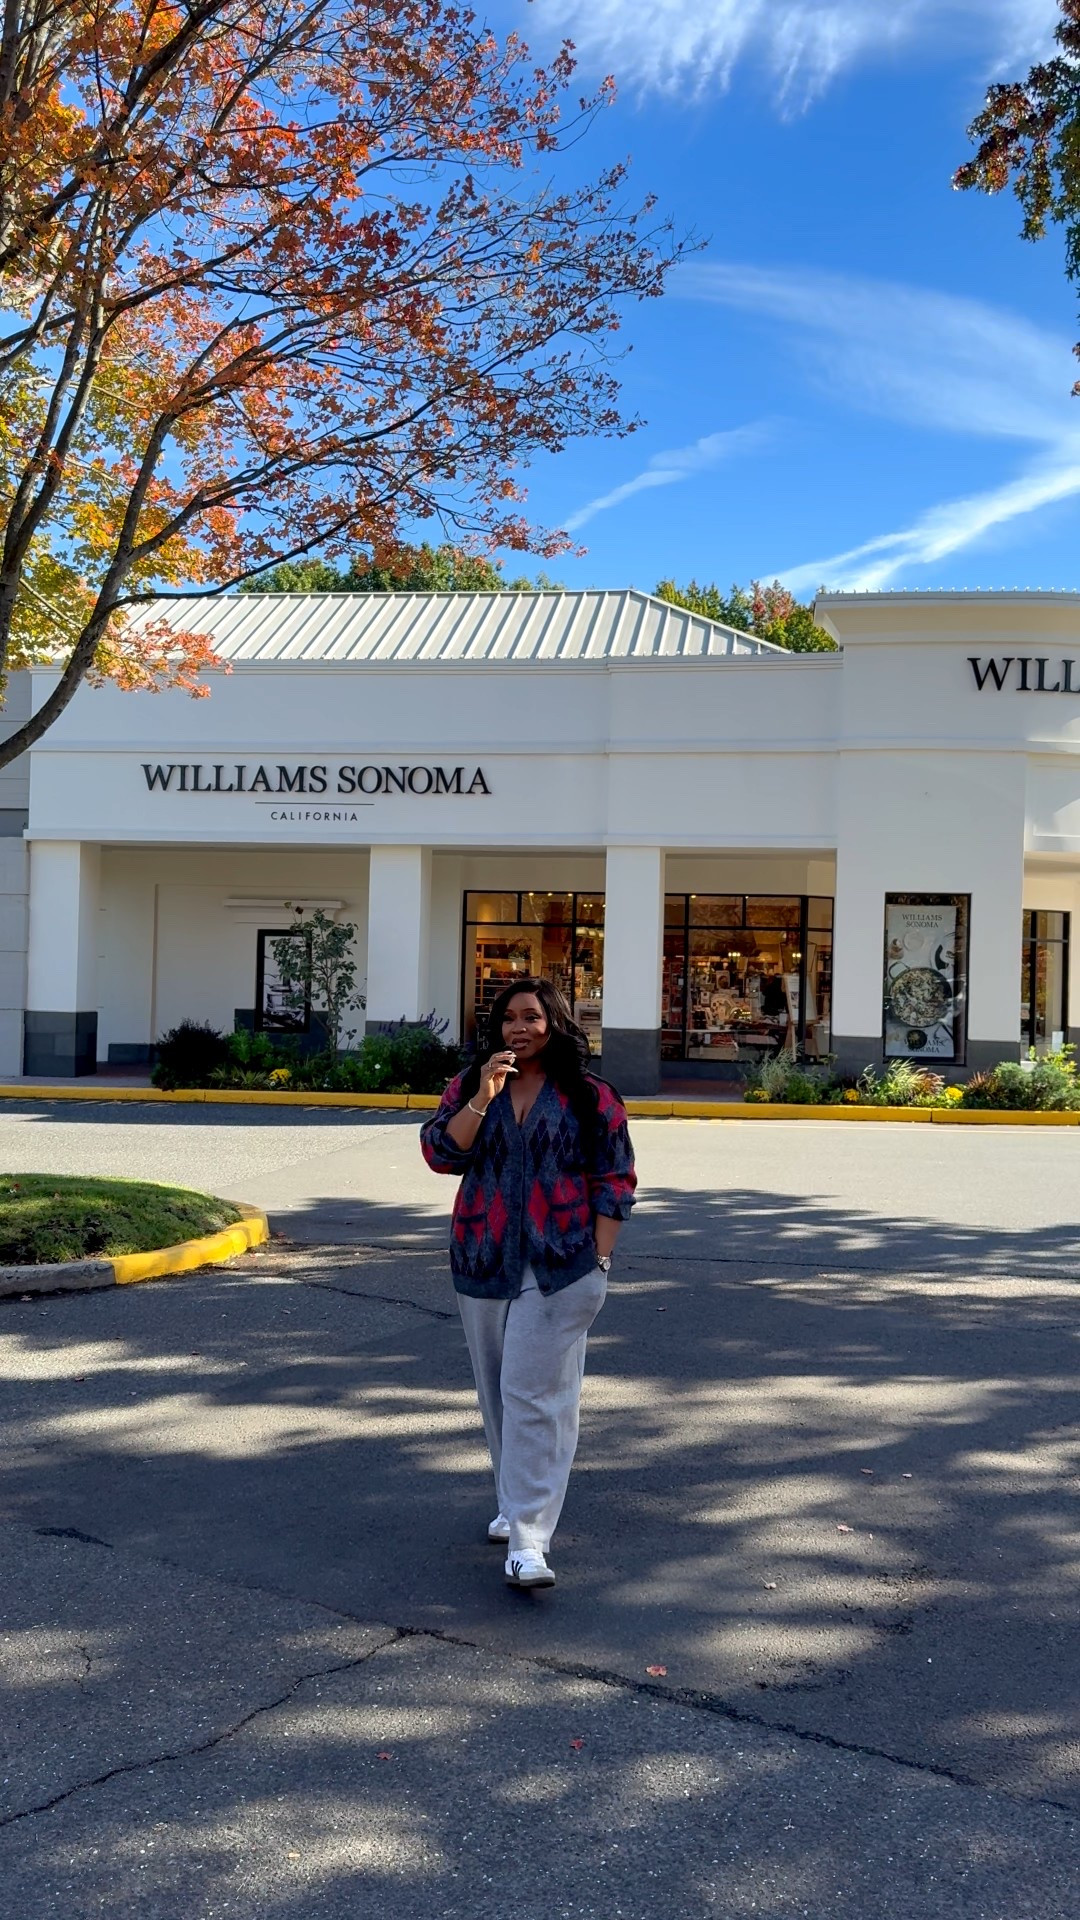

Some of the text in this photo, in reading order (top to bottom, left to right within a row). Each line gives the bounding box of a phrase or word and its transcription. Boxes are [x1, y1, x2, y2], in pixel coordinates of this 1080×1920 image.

[141, 764, 492, 795] WILLIAMS SONOMA
[270, 811, 358, 822] CALIFORNIA
[902, 913, 943, 921] WILLIAMS
[906, 920, 939, 928] SONOMA
